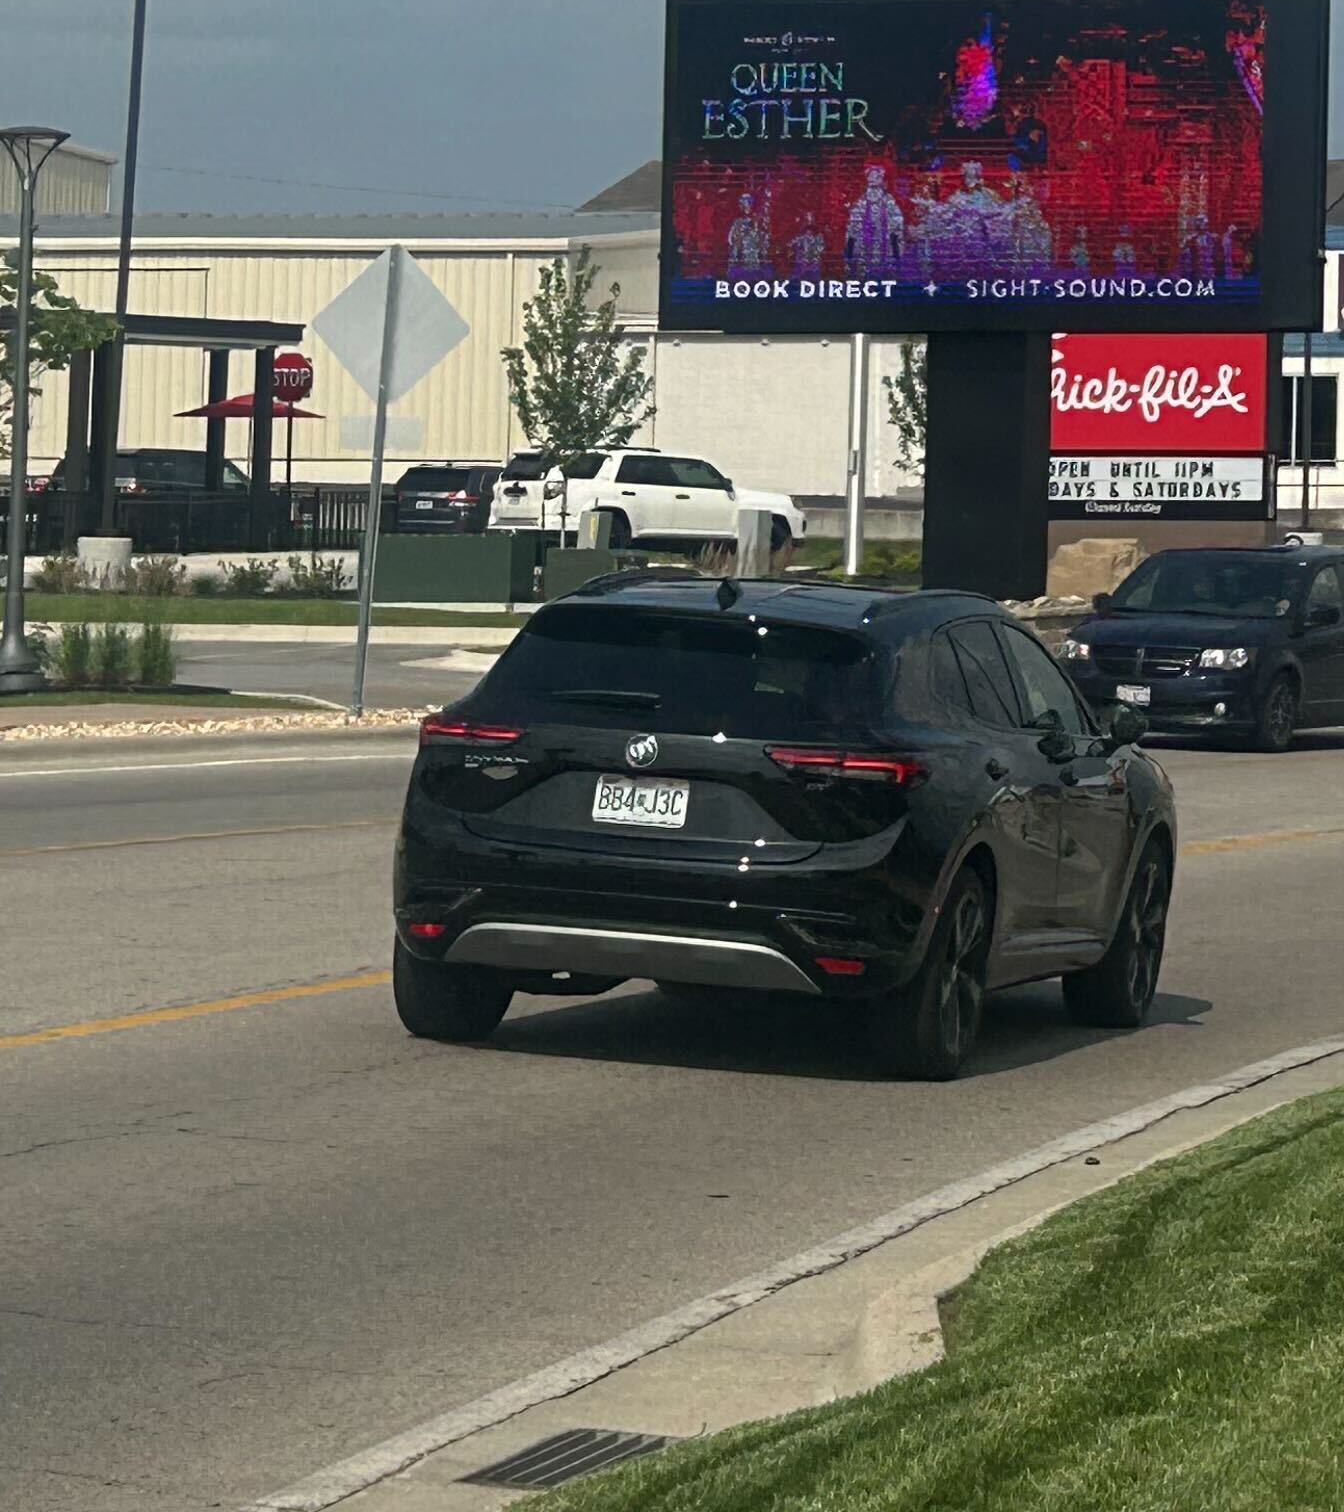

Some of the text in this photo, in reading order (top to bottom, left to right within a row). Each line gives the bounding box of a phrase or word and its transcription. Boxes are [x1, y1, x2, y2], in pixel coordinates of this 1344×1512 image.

[731, 62, 844, 95] QUEEN
[702, 99, 884, 142] ESTHER
[715, 280, 790, 298] BOOK
[800, 280, 897, 298] DIRECT
[273, 368, 310, 387] STOP
[1050, 364, 1249, 422] hick-fil-A
[1110, 461, 1161, 478] UNTIL
[1174, 461, 1215, 479] 11PM
[1132, 482, 1242, 498] SATURDAYS
